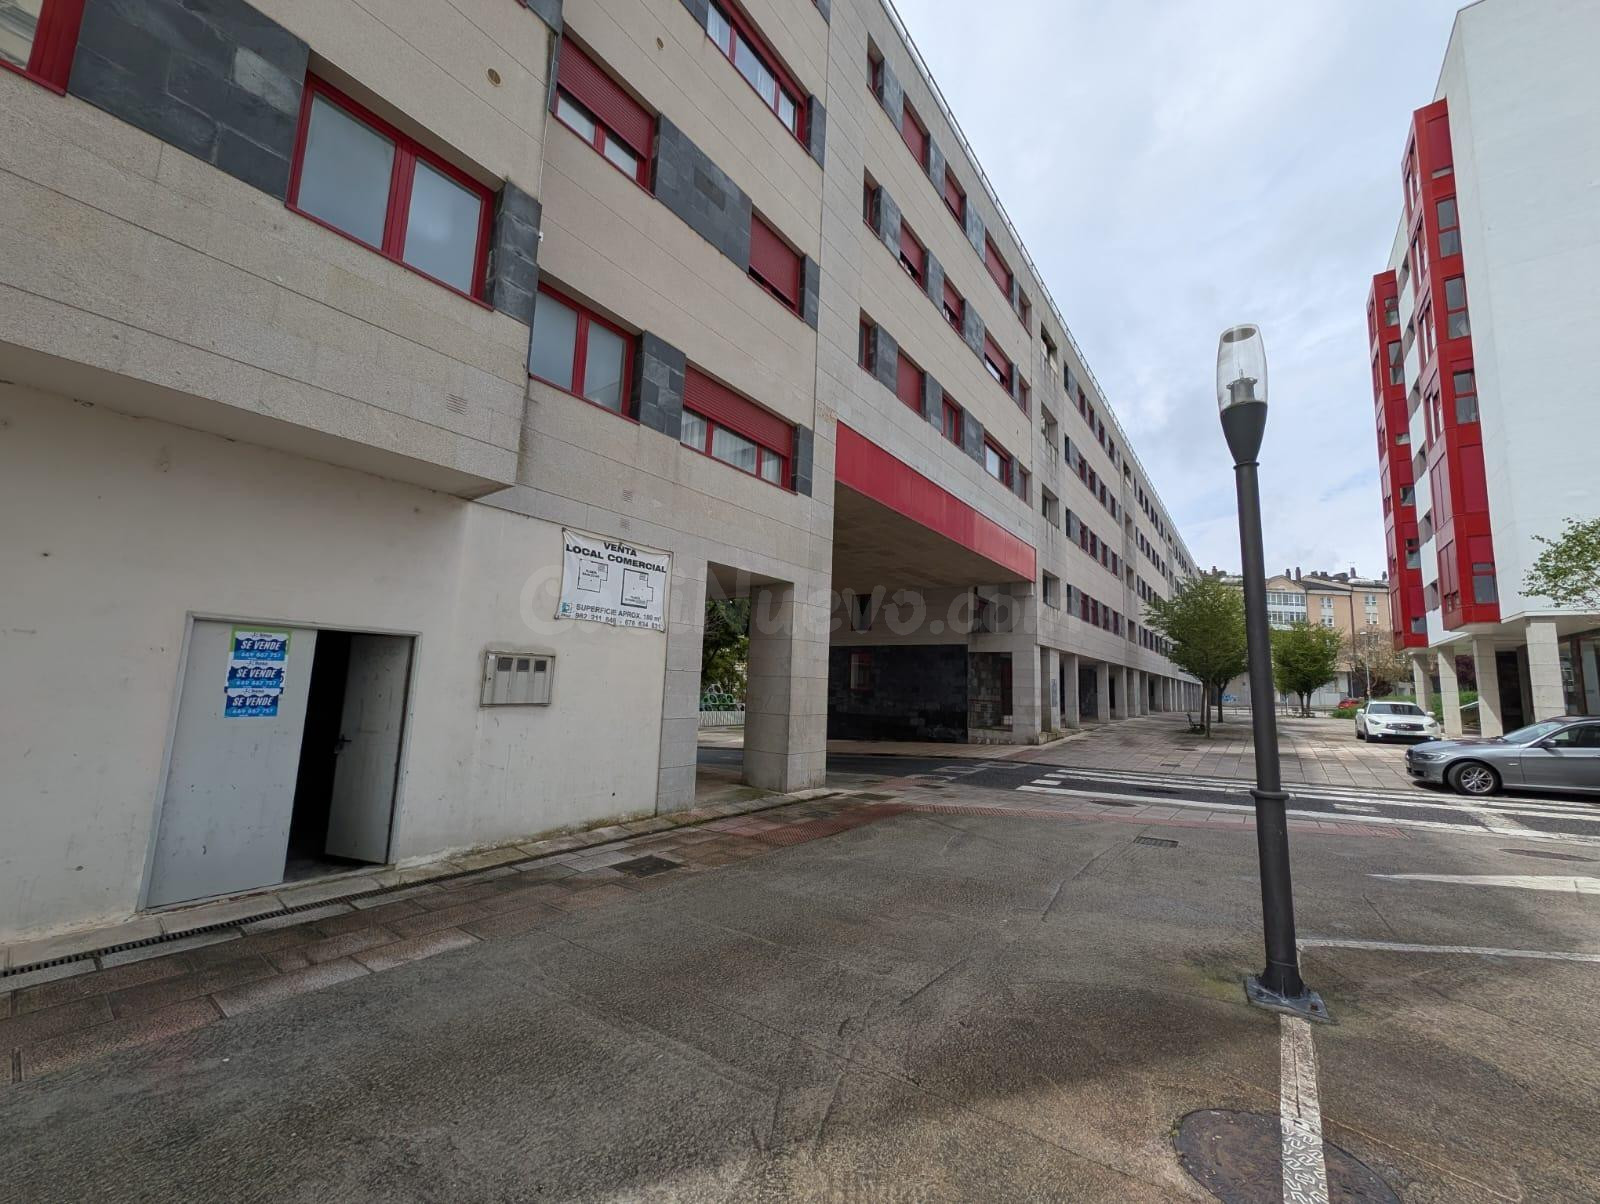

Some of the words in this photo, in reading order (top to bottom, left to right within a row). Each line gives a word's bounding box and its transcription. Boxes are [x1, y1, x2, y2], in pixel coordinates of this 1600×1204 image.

[603, 542, 638, 557] VENTA
[565, 543, 604, 560] LOCAL
[607, 554, 667, 574] COMERCIAL
[575, 603, 617, 616] SUPERFICIE
[617, 610, 641, 620] APROX.
[240, 640, 254, 650] SE
[254, 640, 281, 650] VENDE
[236, 668, 250, 678] SE
[249, 668, 277, 678] VENDE
[232, 696, 246, 706] SE
[245, 696, 273, 706] VENDE
